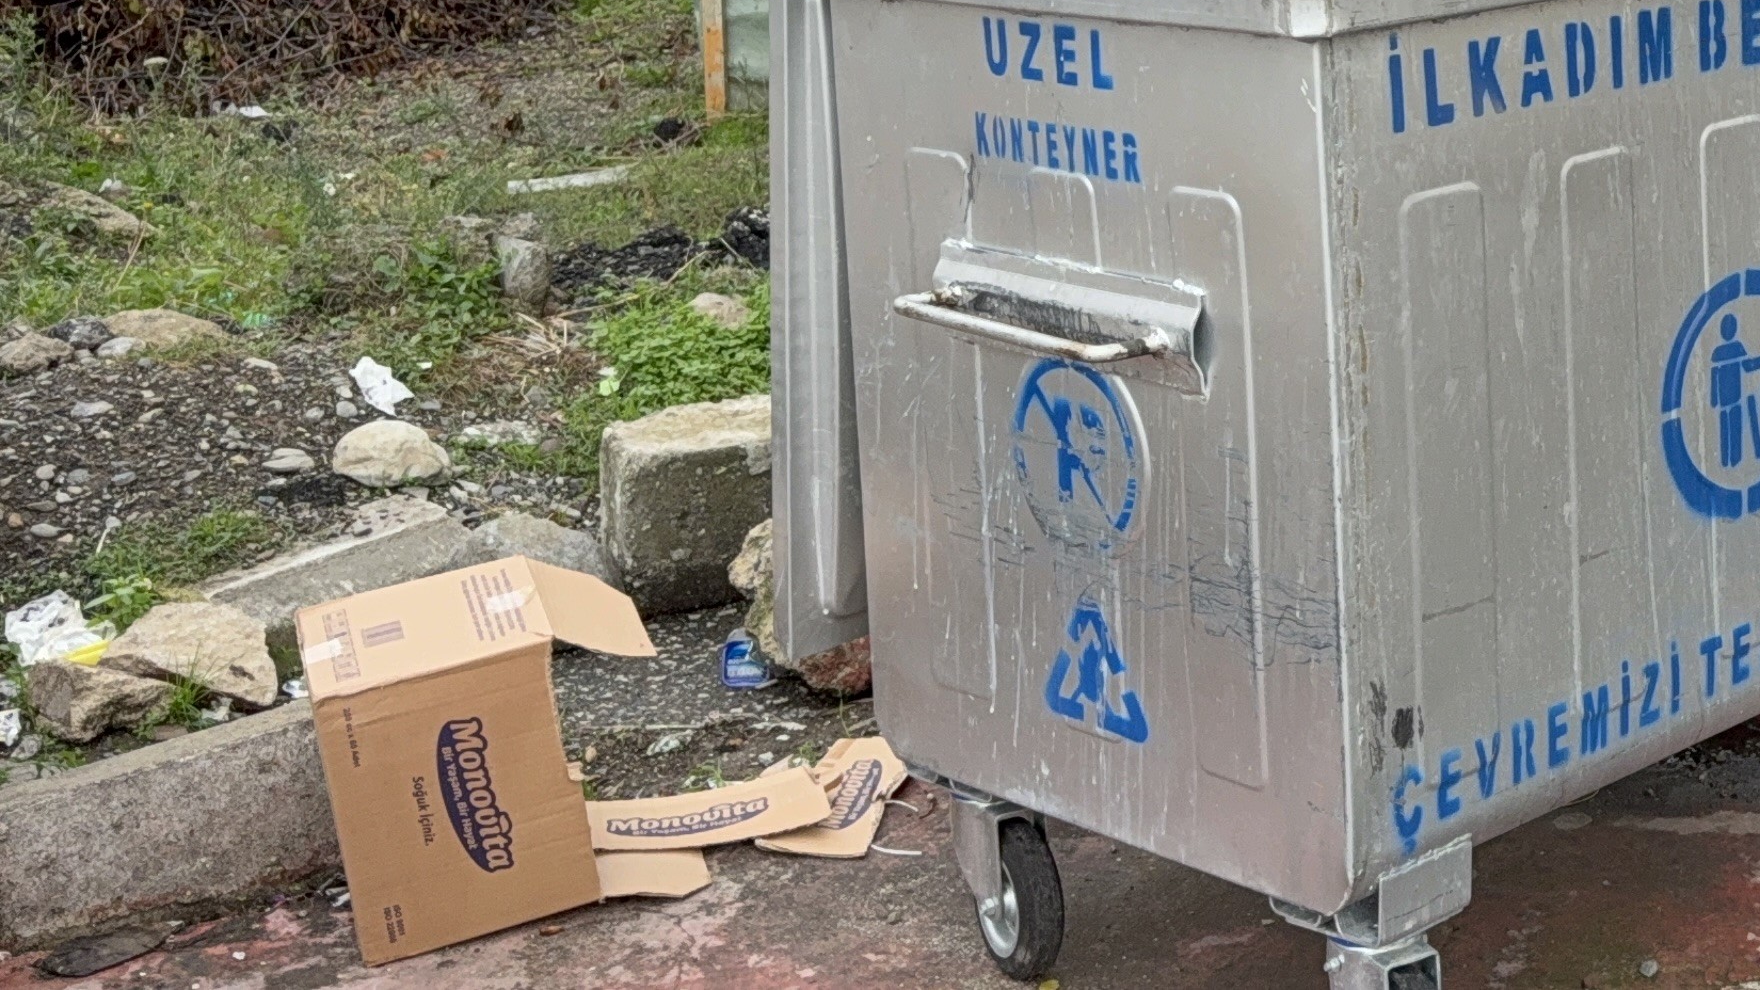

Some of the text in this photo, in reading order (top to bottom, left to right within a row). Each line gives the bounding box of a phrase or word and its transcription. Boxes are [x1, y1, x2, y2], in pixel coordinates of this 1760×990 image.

[983, 17, 1116, 92] UZEL
[1388, 7, 1674, 134] İLKADIM
[974, 111, 1142, 185] KONTEYNER
[441, 746, 454, 762] Bir
[1391, 640, 1683, 857] ÇEVREMİZİ
[411, 776, 436, 847] Soğuk İçiniz.
[456, 801, 470, 817] Bir
[460, 817, 479, 850] Hayat
